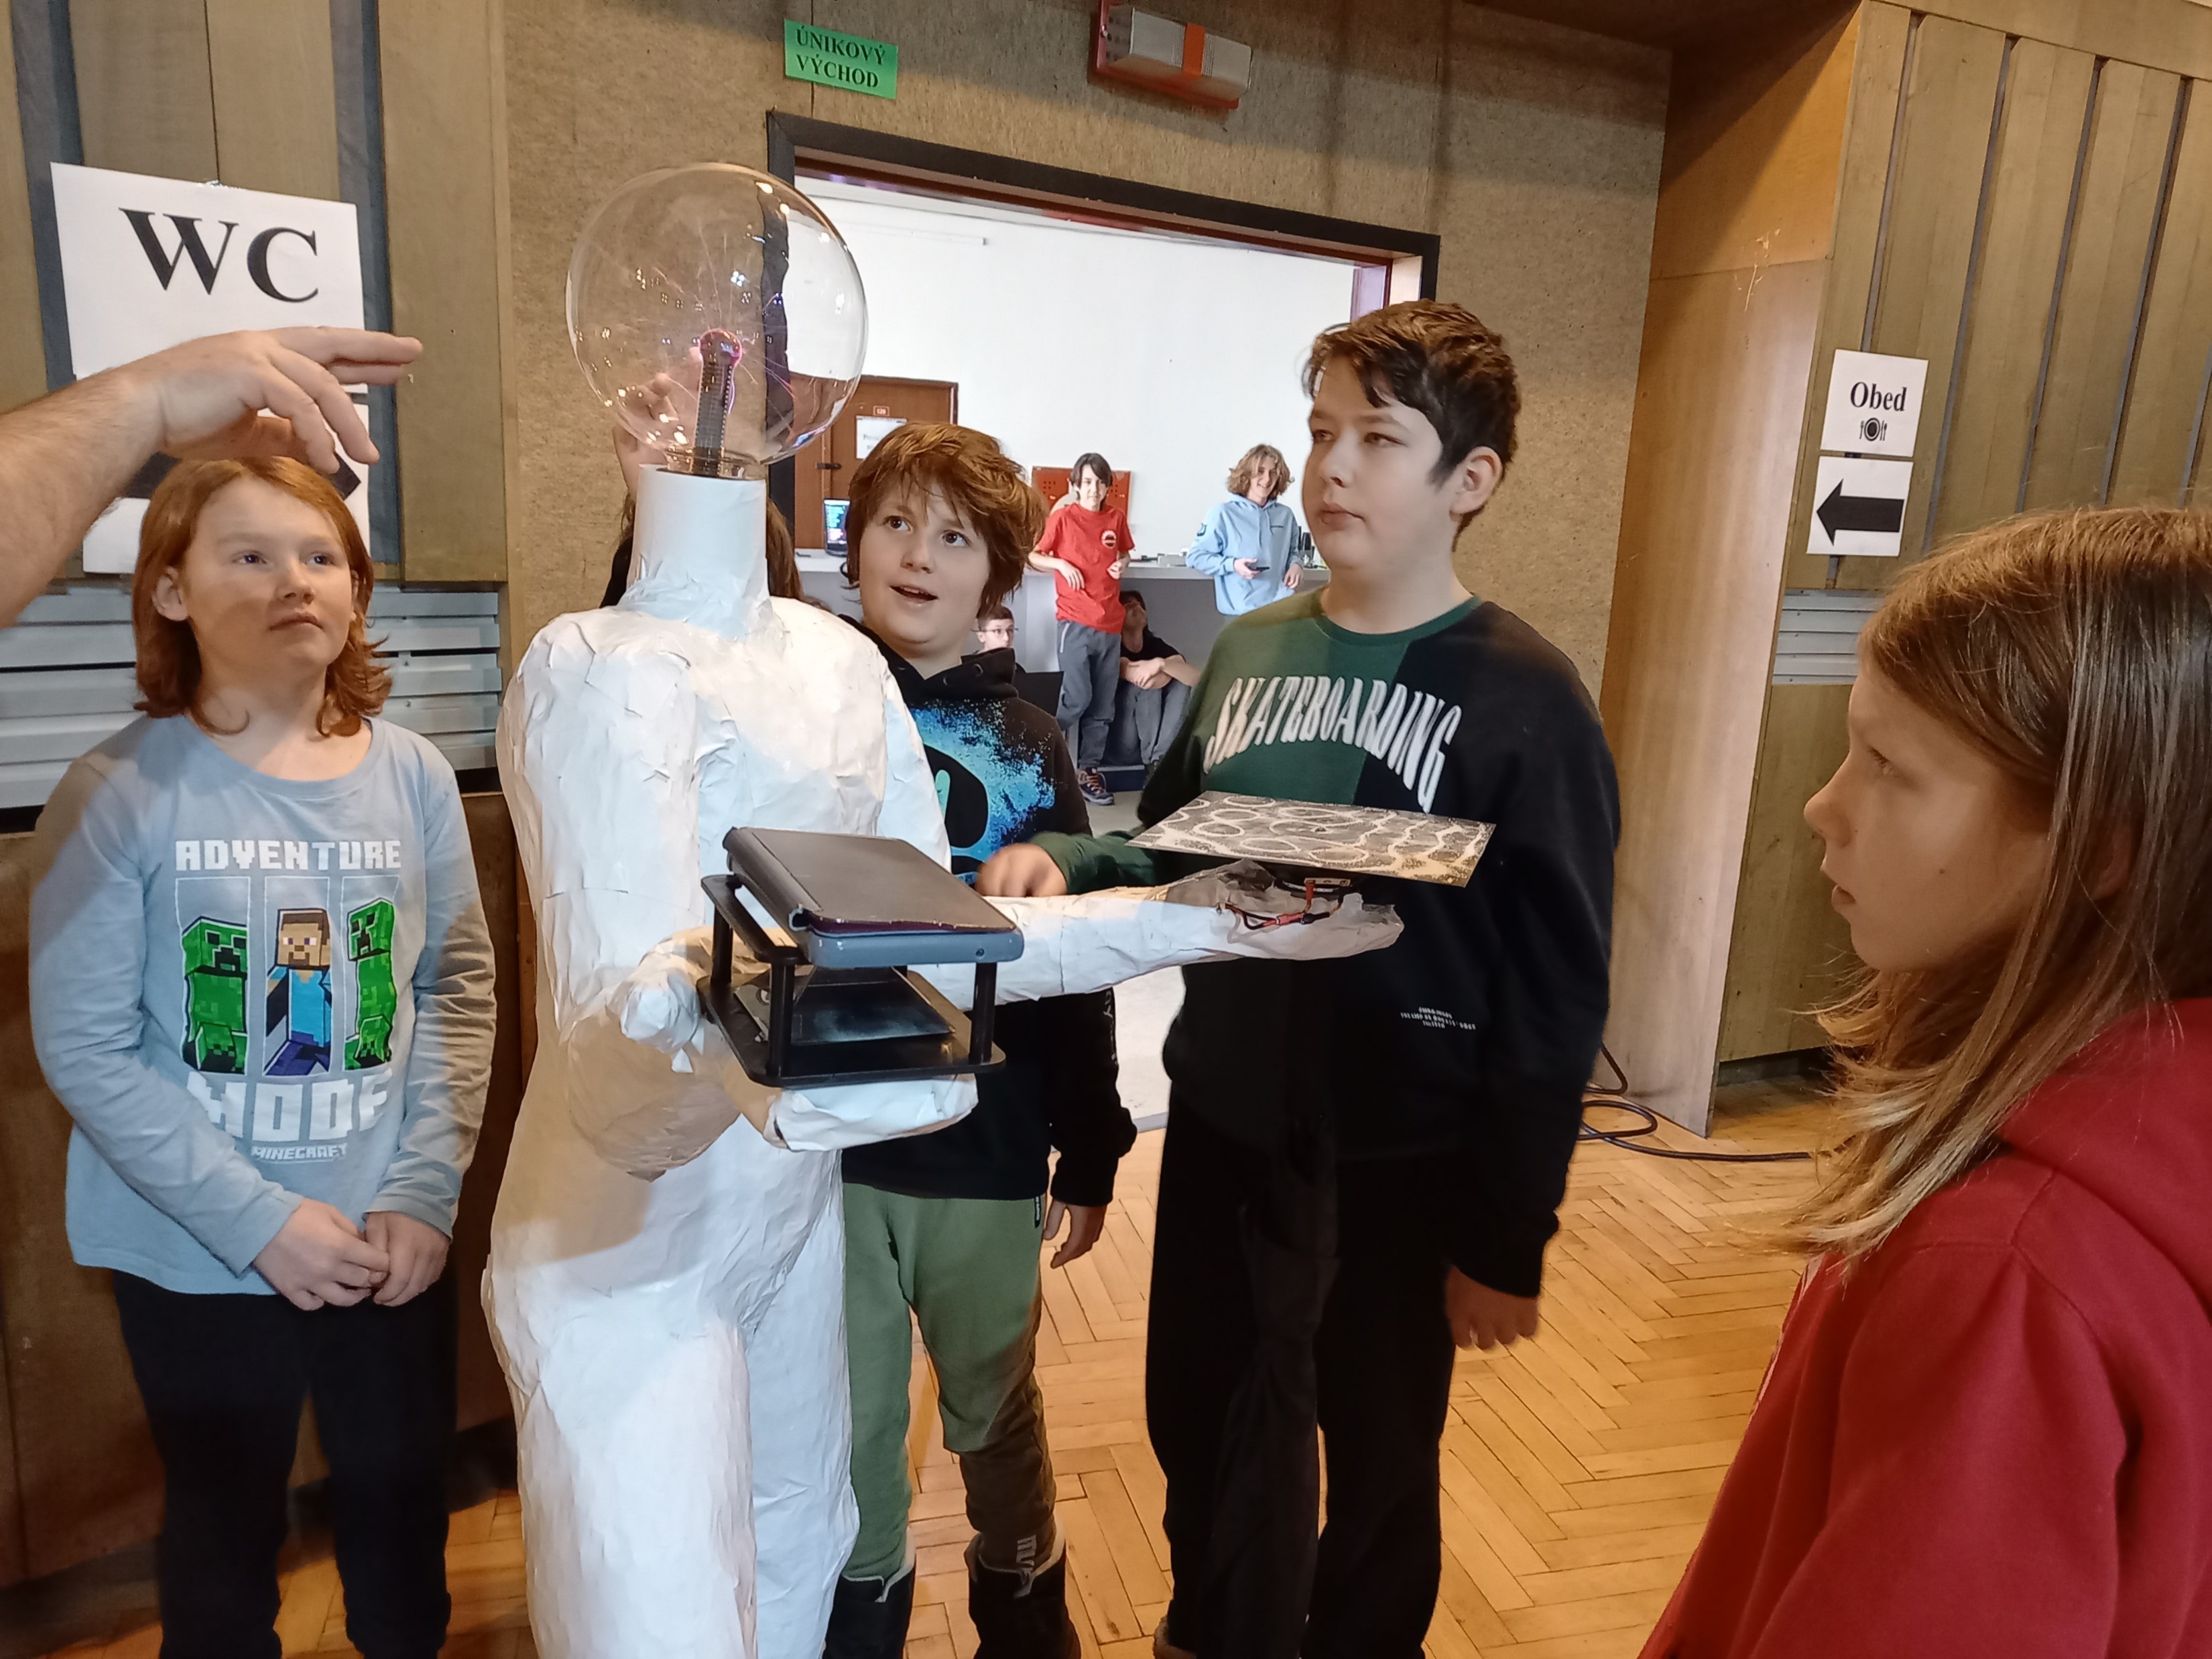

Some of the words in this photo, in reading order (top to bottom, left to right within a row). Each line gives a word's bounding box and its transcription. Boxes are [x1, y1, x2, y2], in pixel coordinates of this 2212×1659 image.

[796, 25, 886, 66] ÚNIKOVÝ
[796, 53, 879, 88] VÝCHOD
[118, 207, 319, 304] WC
[1850, 381, 1908, 412] Obed
[1203, 675, 1463, 814] SKATEBOARDING
[175, 840, 402, 871] ADVENTURE
[250, 1142, 348, 1160] MINECRAFT
